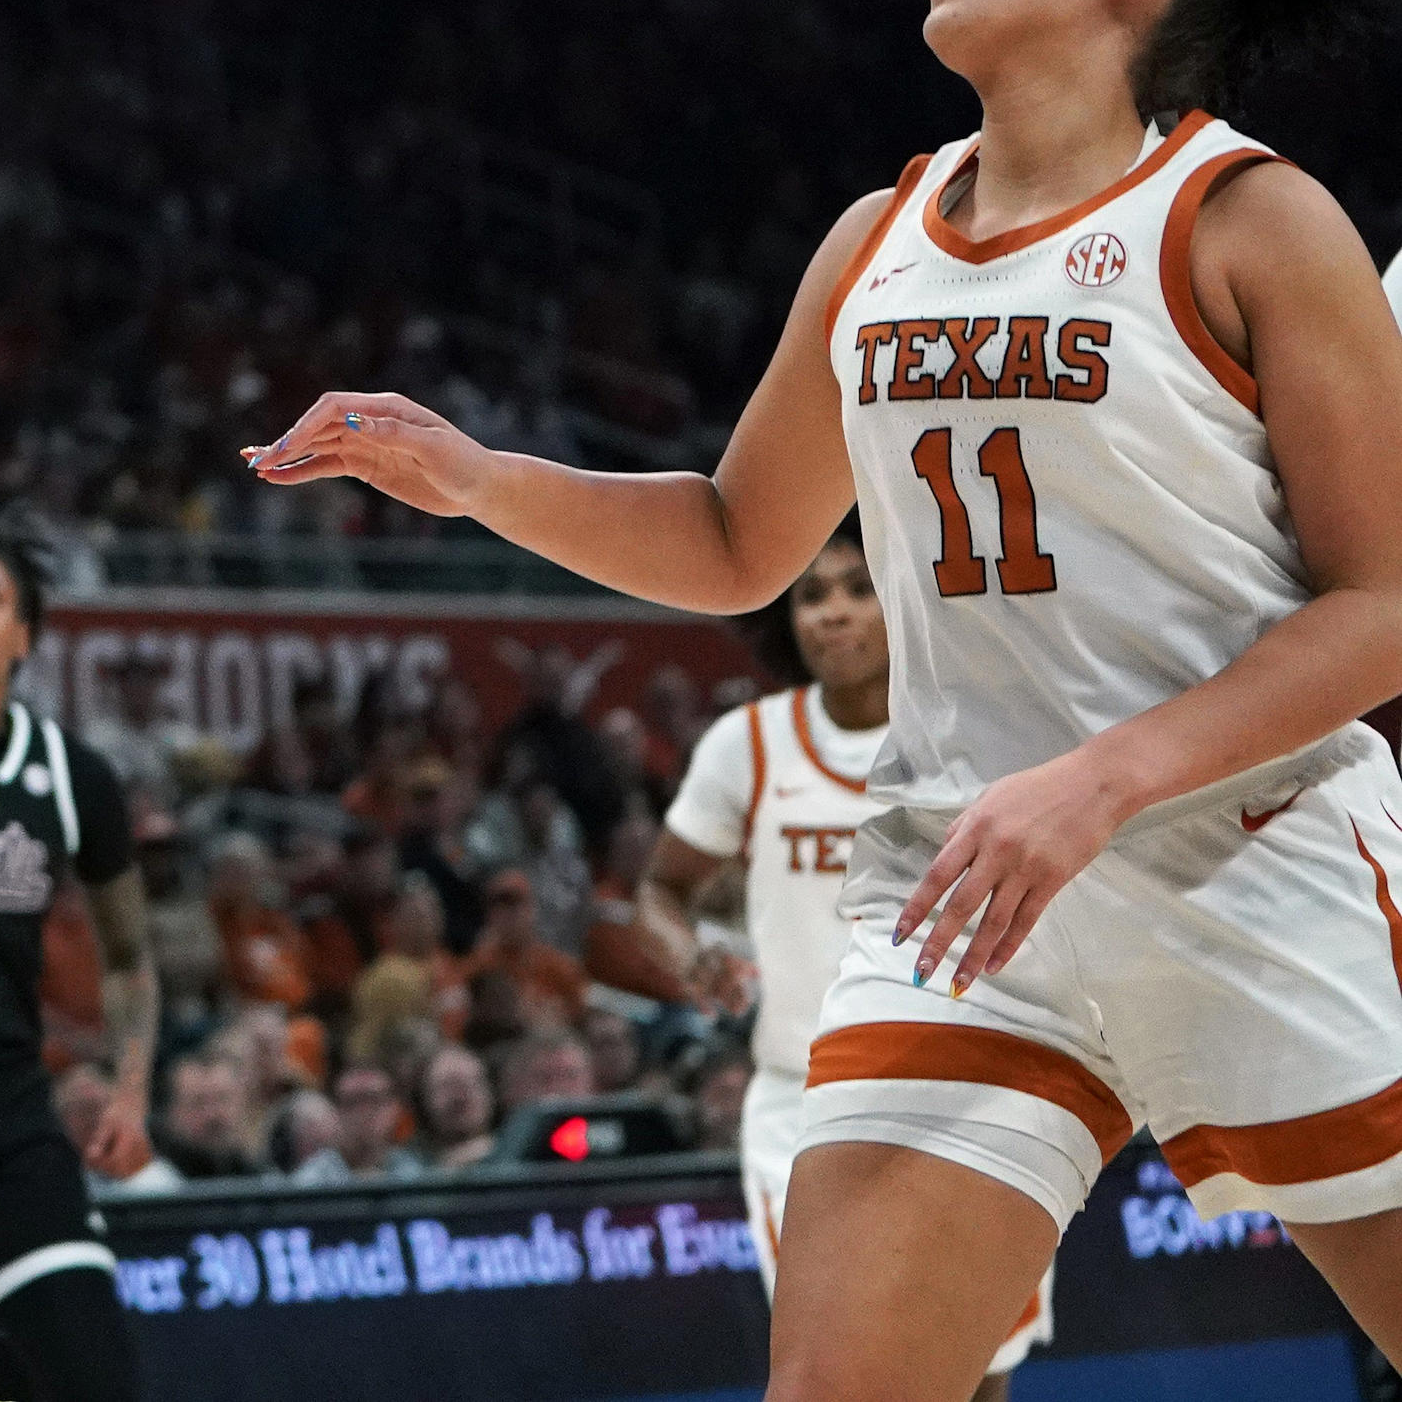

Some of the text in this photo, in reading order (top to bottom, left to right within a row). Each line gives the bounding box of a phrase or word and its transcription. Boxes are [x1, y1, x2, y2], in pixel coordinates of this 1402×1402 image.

[1066, 233, 1127, 287] SEC
[855, 315, 1113, 405] TEXAS
[910, 427, 1058, 598] 11
[779, 824, 856, 873] TE
[114, 1256, 188, 1314] ver
[407, 1218, 584, 1296] Brands
[582, 1206, 657, 1282] for
[656, 1202, 762, 1277] Eve
